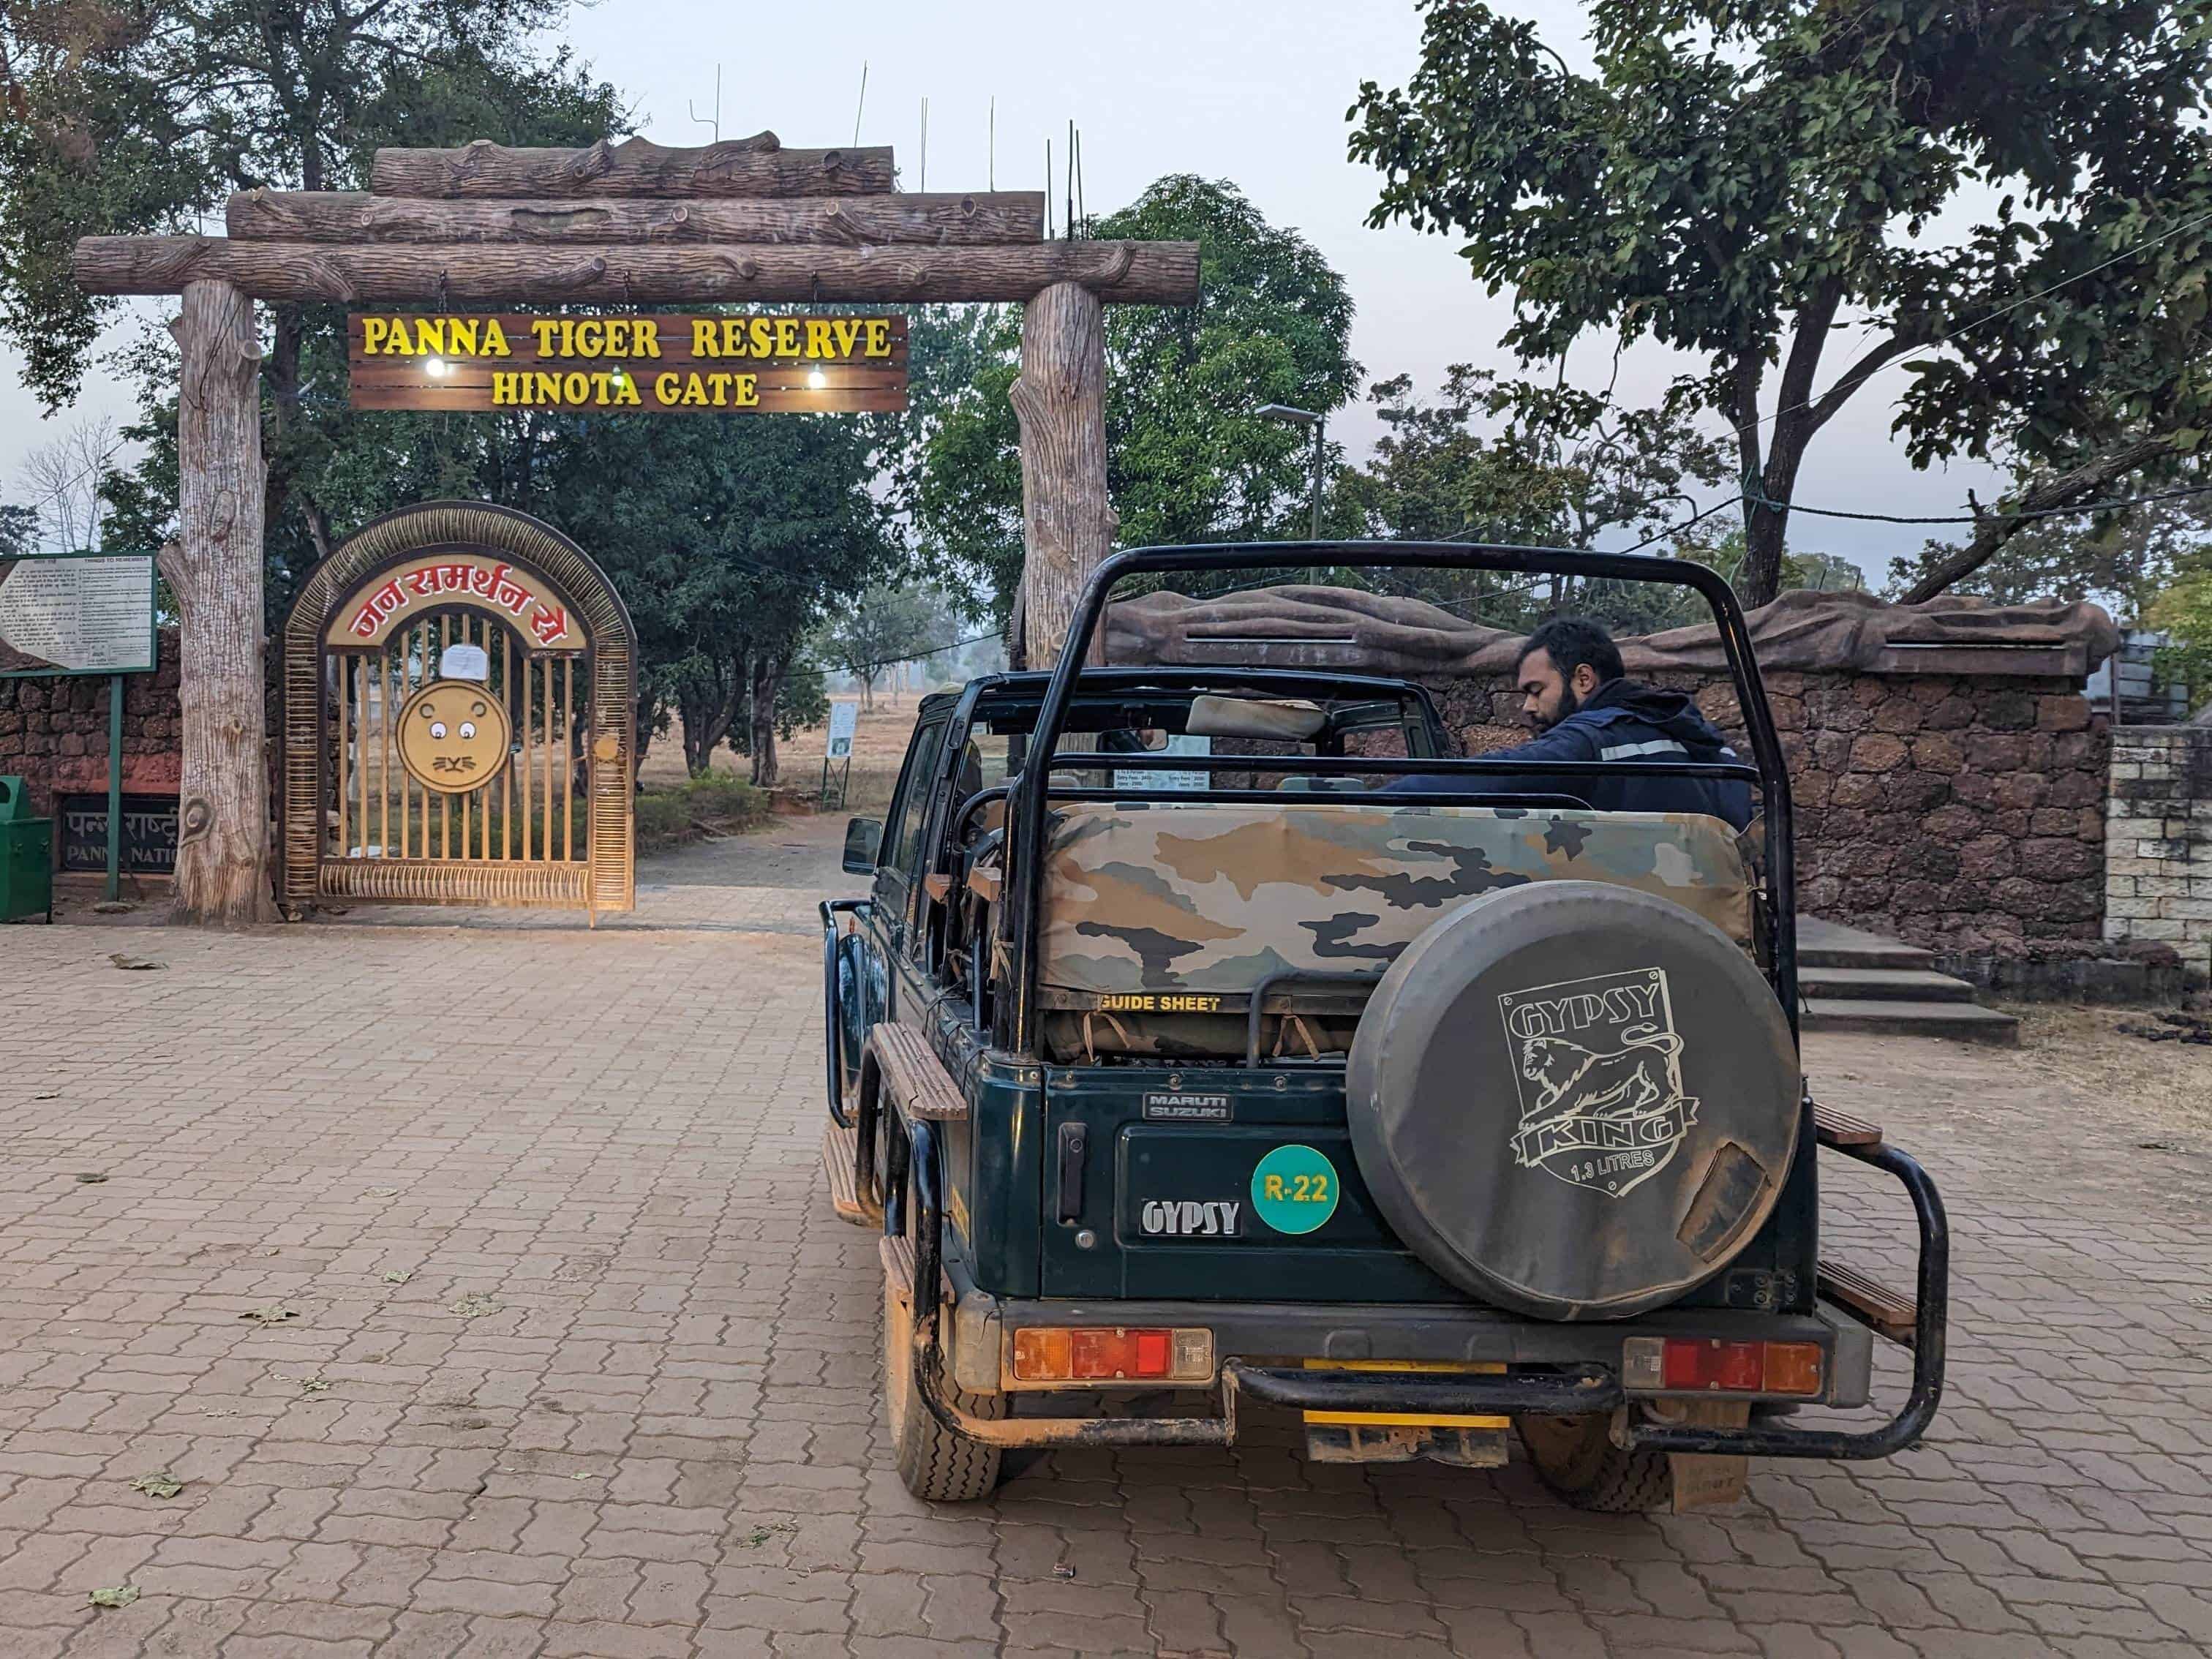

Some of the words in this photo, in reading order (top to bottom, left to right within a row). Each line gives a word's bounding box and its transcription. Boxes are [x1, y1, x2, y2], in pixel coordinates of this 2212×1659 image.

[363, 317, 511, 356] PANNA
[532, 320, 661, 358] TIGER
[691, 318, 891, 358] RESERVE
[492, 372, 642, 405] HINOTA
[655, 372, 760, 406] GATE
[67, 846, 123, 862] PANN
[1101, 995, 1154, 1010] GUIDE
[1159, 996, 1221, 1011] SHEET
[1509, 982, 1660, 1039] GYPSY
[1149, 1096, 1227, 1106] MARUTI
[1149, 1107, 1227, 1118] SUZUKI
[1521, 1116, 1674, 1166] KING
[1570, 1162, 1595, 1182] 1.3
[1597, 1149, 1655, 1175] LITRES
[1264, 1174, 1328, 1202] R-22
[1142, 1200, 1241, 1234] GYPSY
